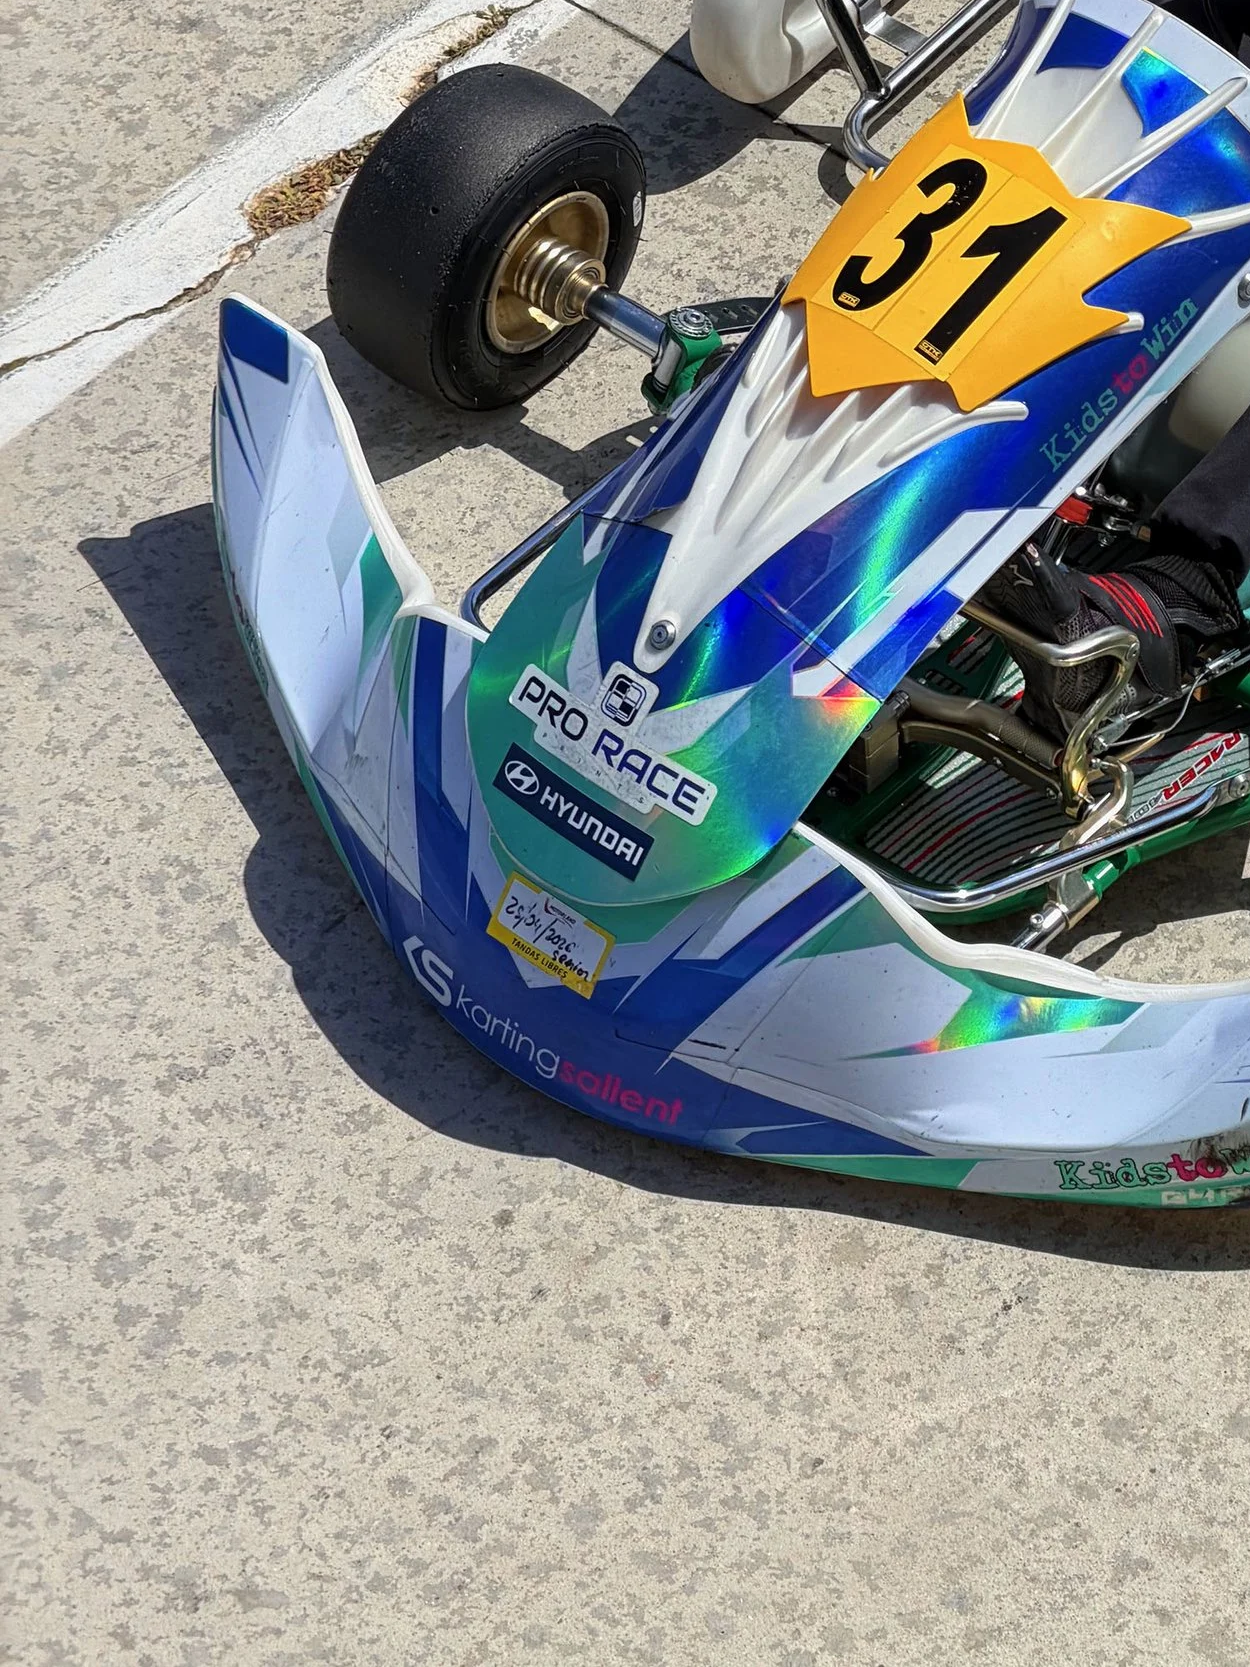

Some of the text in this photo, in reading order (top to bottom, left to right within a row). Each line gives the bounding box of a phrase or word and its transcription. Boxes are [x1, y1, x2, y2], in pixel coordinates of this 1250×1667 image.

[832, 158, 1068, 366] 31
[518, 675, 706, 816] PRO RACE
[1159, 731, 1246, 801] RACER
[539, 785, 645, 867] HYUNDAI
[510, 936, 569, 980] TANDAS LIBRES
[455, 984, 684, 1126] kartingsallent
